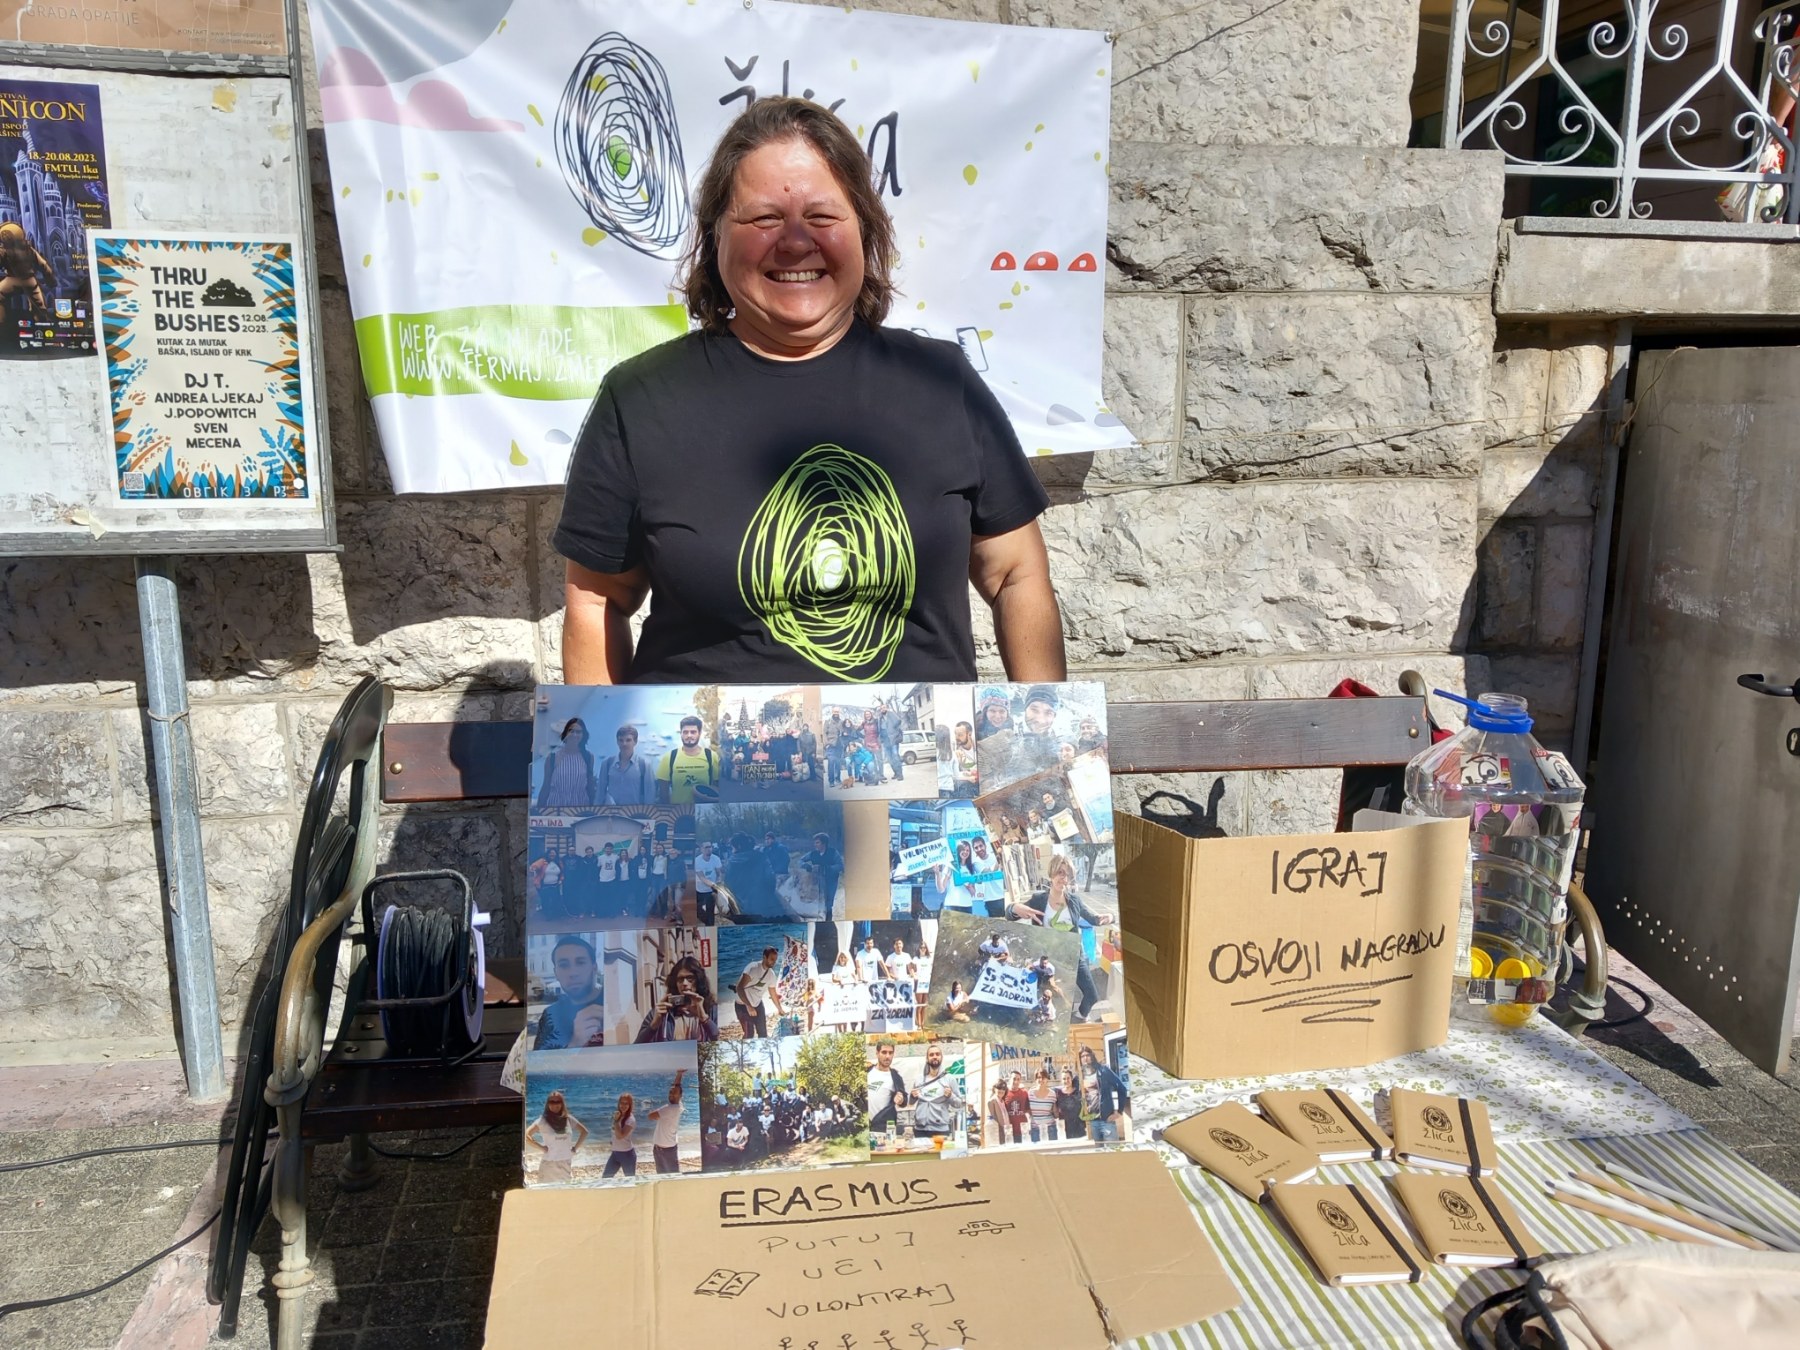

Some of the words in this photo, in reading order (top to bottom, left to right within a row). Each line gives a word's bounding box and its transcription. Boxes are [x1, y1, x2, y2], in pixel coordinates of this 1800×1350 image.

[26, 5, 79, 20] GRADA
[82, 8, 140, 25] OPATIJE
[28, 151, 97, 162] 18.-20.08.2023.
[45, 163, 80, 174] FMTU,
[83, 164, 98, 174] Ika
[150, 266, 207, 285] THRU
[152, 290, 195, 308] THE
[155, 313, 240, 332] BUSHES
[241, 314, 269, 322] 12.08.
[242, 325, 269, 333] 2023.
[399, 321, 437, 353] WEB
[157, 338, 184, 346] KUTAK
[199, 339, 227, 347] MUTAK
[158, 347, 188, 356] BAŠKA,
[235, 349, 252, 357] KRK
[185, 373, 208, 388] DJ
[214, 374, 229, 388] T.
[155, 392, 208, 403] ANDREA
[212, 393, 264, 404] LJEKAJ
[165, 408, 257, 419] J.POPOWITCH
[194, 423, 228, 433] SVEN
[186, 438, 241, 448] MECENA
[1272, 847, 1388, 896] IGRAJ
[1208, 938, 1321, 985] OSVOJI
[1340, 923, 1445, 971] NAGRADU
[980, 983, 996, 995] ZA
[996, 987, 1034, 1005] JADRAN
[995, 1044, 1019, 1060] DAN
[720, 1179, 938, 1218] ERASMUS
[954, 1179, 981, 1192] +
[758, 1232, 914, 1253] PUTUJ
[766, 1283, 955, 1318] VOLONTIRAJ
